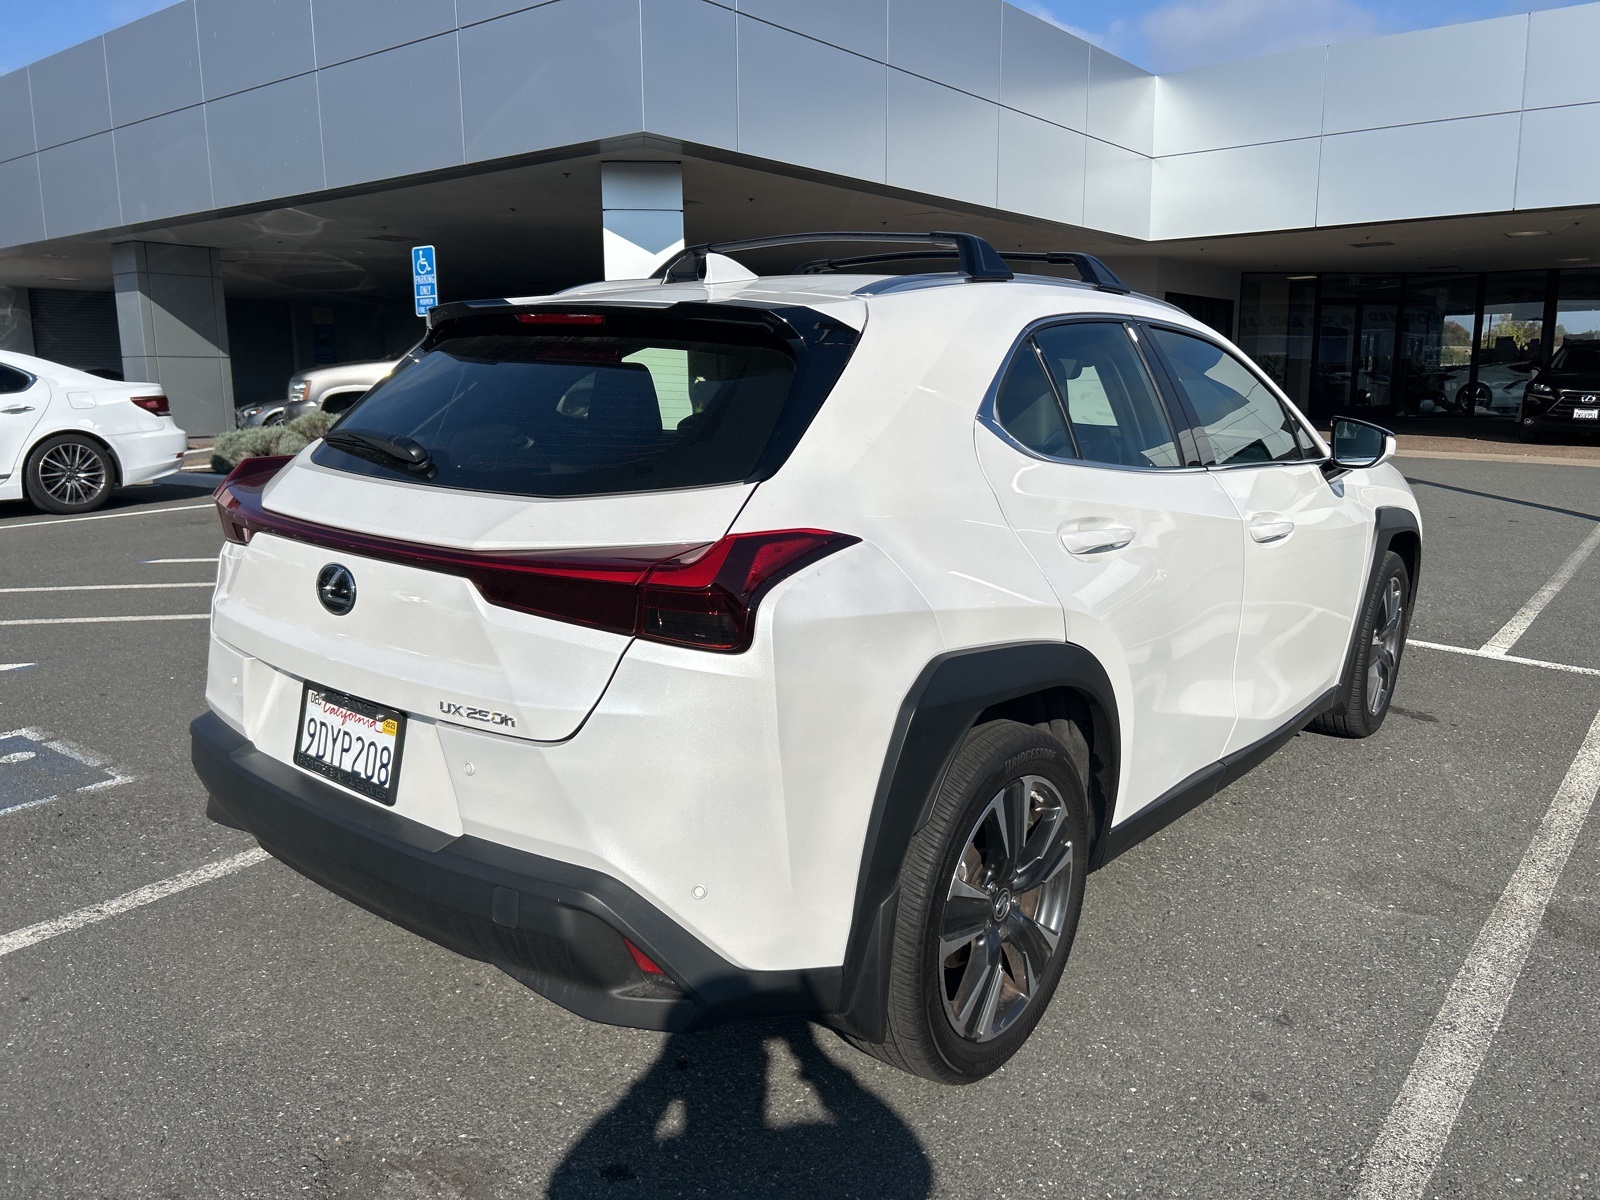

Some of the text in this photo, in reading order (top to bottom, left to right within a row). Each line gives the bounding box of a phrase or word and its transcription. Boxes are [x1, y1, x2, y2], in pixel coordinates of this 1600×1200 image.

[415, 274, 435, 284] PARKING
[420, 285, 431, 295] ONLY
[311, 692, 322, 705] DEC
[323, 701, 383, 733] California
[304, 717, 392, 787] 9DYP208
[1004, 747, 1056, 774] BRIDGESTONE
[349, 776, 386, 799] LEXUS
